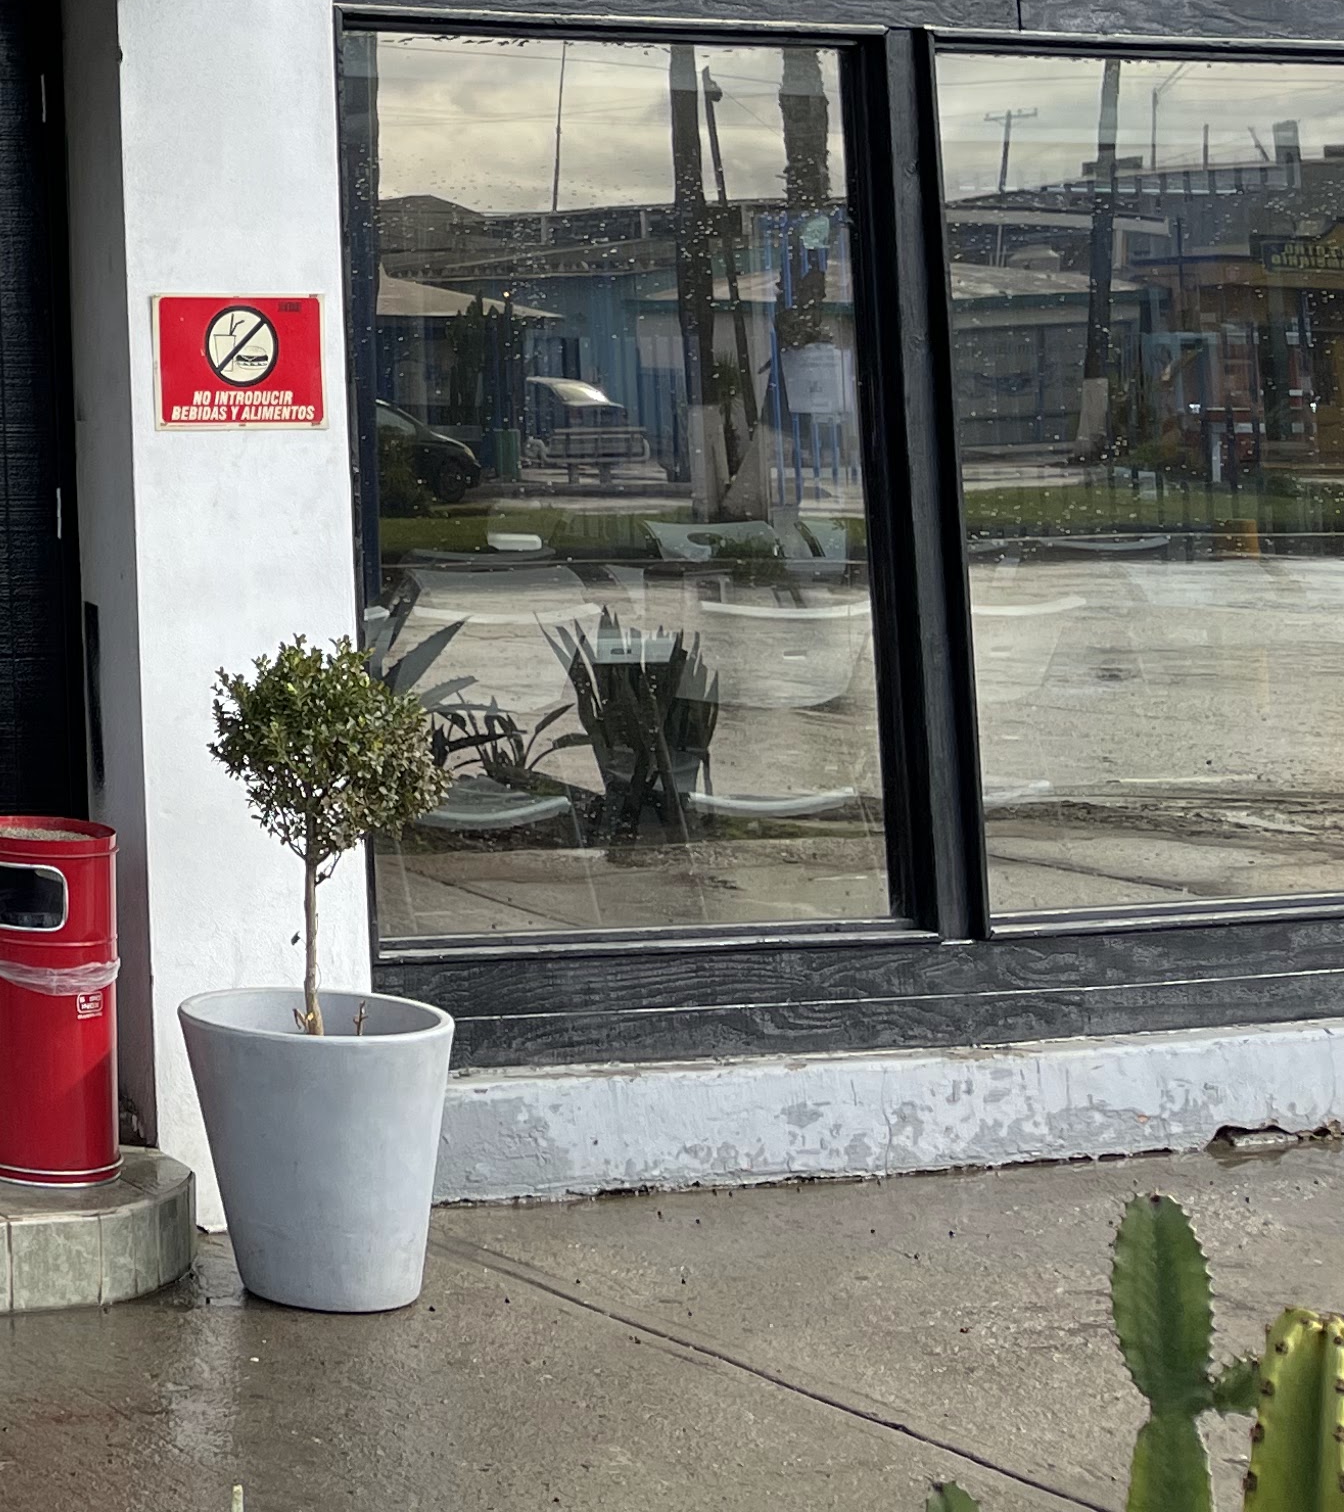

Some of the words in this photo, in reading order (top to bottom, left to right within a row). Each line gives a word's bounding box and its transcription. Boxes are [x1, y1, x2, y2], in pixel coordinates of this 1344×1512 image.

[193, 391, 211, 405] NO
[215, 391, 293, 405] INTRODUCIR
[171, 406, 227, 420] BEBIDAS
[230, 406, 239, 420] Y
[241, 406, 315, 420] ALIMENTOS
